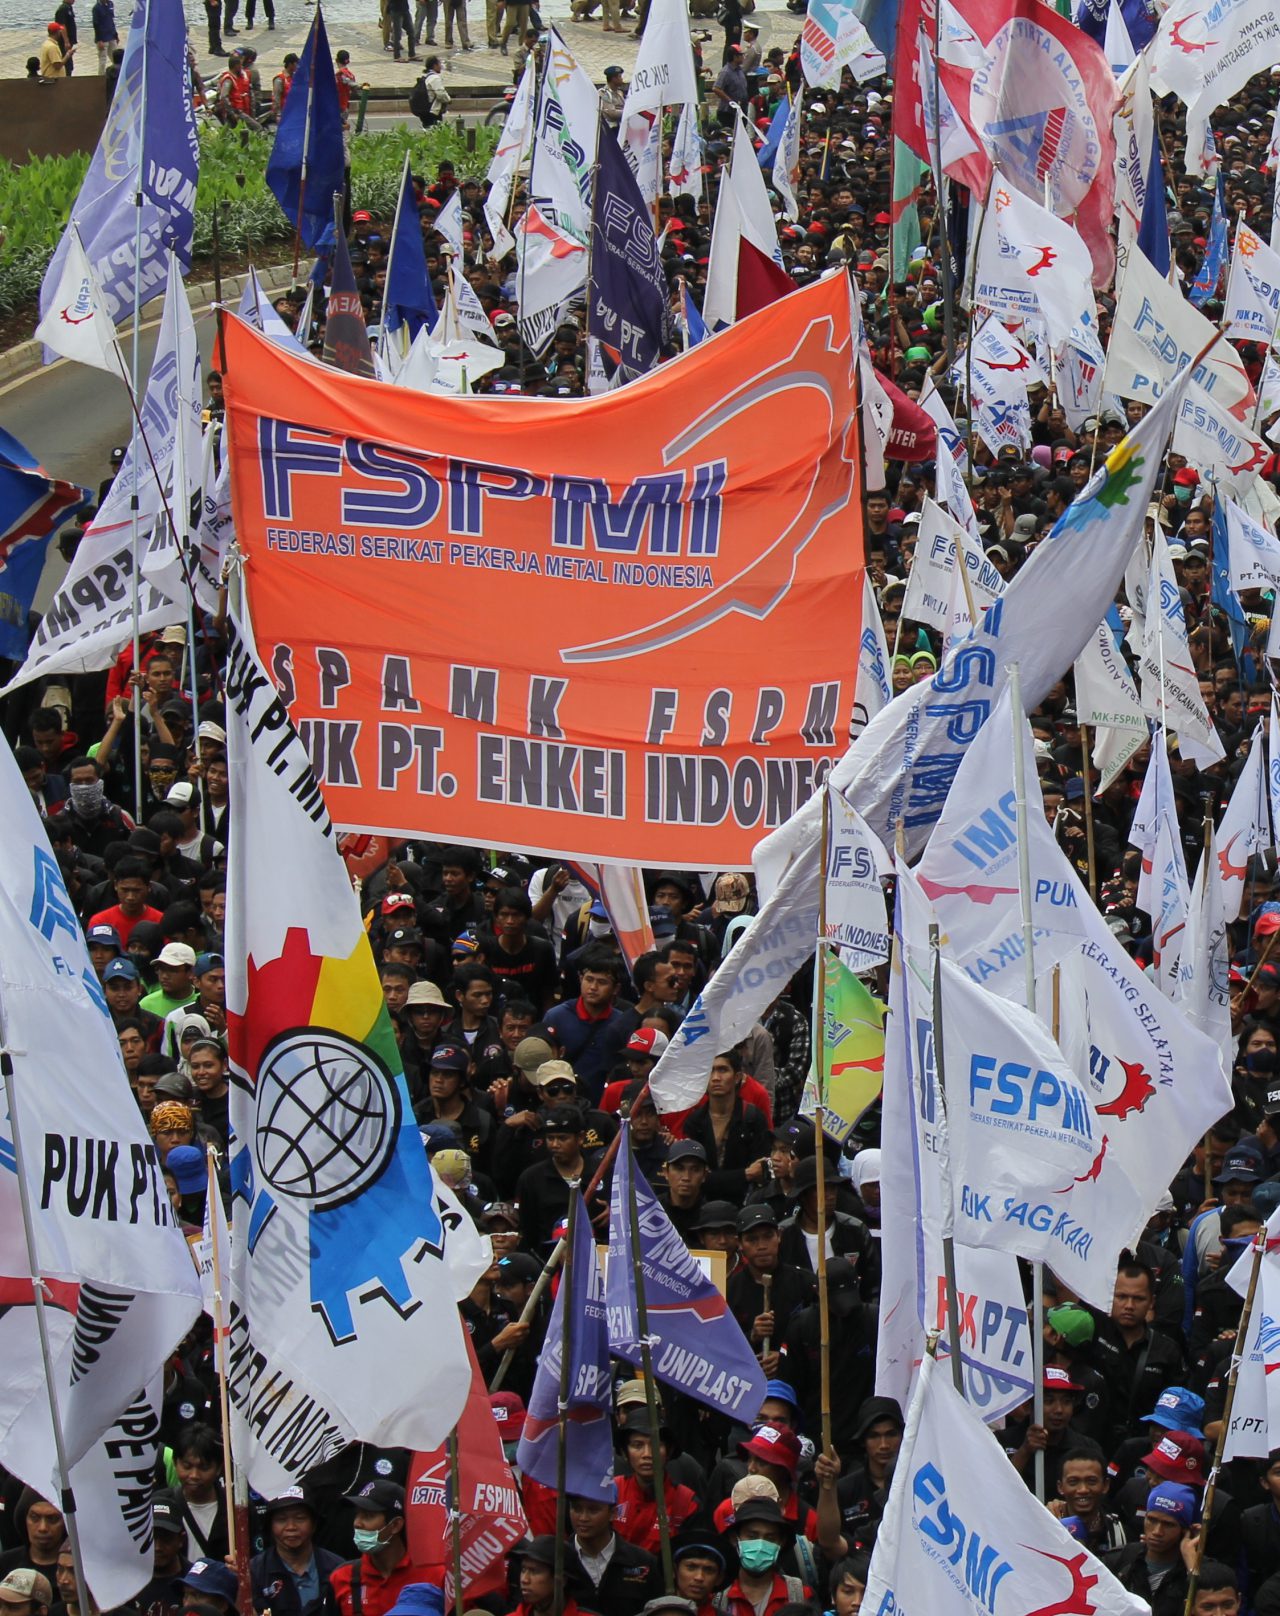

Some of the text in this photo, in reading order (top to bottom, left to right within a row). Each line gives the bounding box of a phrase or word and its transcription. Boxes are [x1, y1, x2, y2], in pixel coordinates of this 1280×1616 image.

[1054, 52, 1086, 108] ALAM
[257, 416, 728, 558] FSPMI
[267, 528, 714, 589] FEDERASI SERIKAT PEKERJA METAL INDONESIA
[1240, 573, 1255, 581] PT.
[298, 719, 361, 789] UK
[378, 721, 458, 798] PT.
[476, 732, 626, 820] ENKEI
[1035, 879, 1079, 909] PUK
[845, 926, 890, 954] INDONES
[1133, 1002, 1175, 1088] SELATAN
[969, 1053, 1093, 1140] FSPMI
[997, 1116, 1026, 1135] SERIKAT
[1025, 1122, 1058, 1140] PEKERJA
[42, 1133, 169, 1229] PUK PT.
[980, 1299, 1028, 1368] PT.
[656, 1342, 753, 1411] UNIPLAST
[473, 1482, 519, 1513] FSPMI
